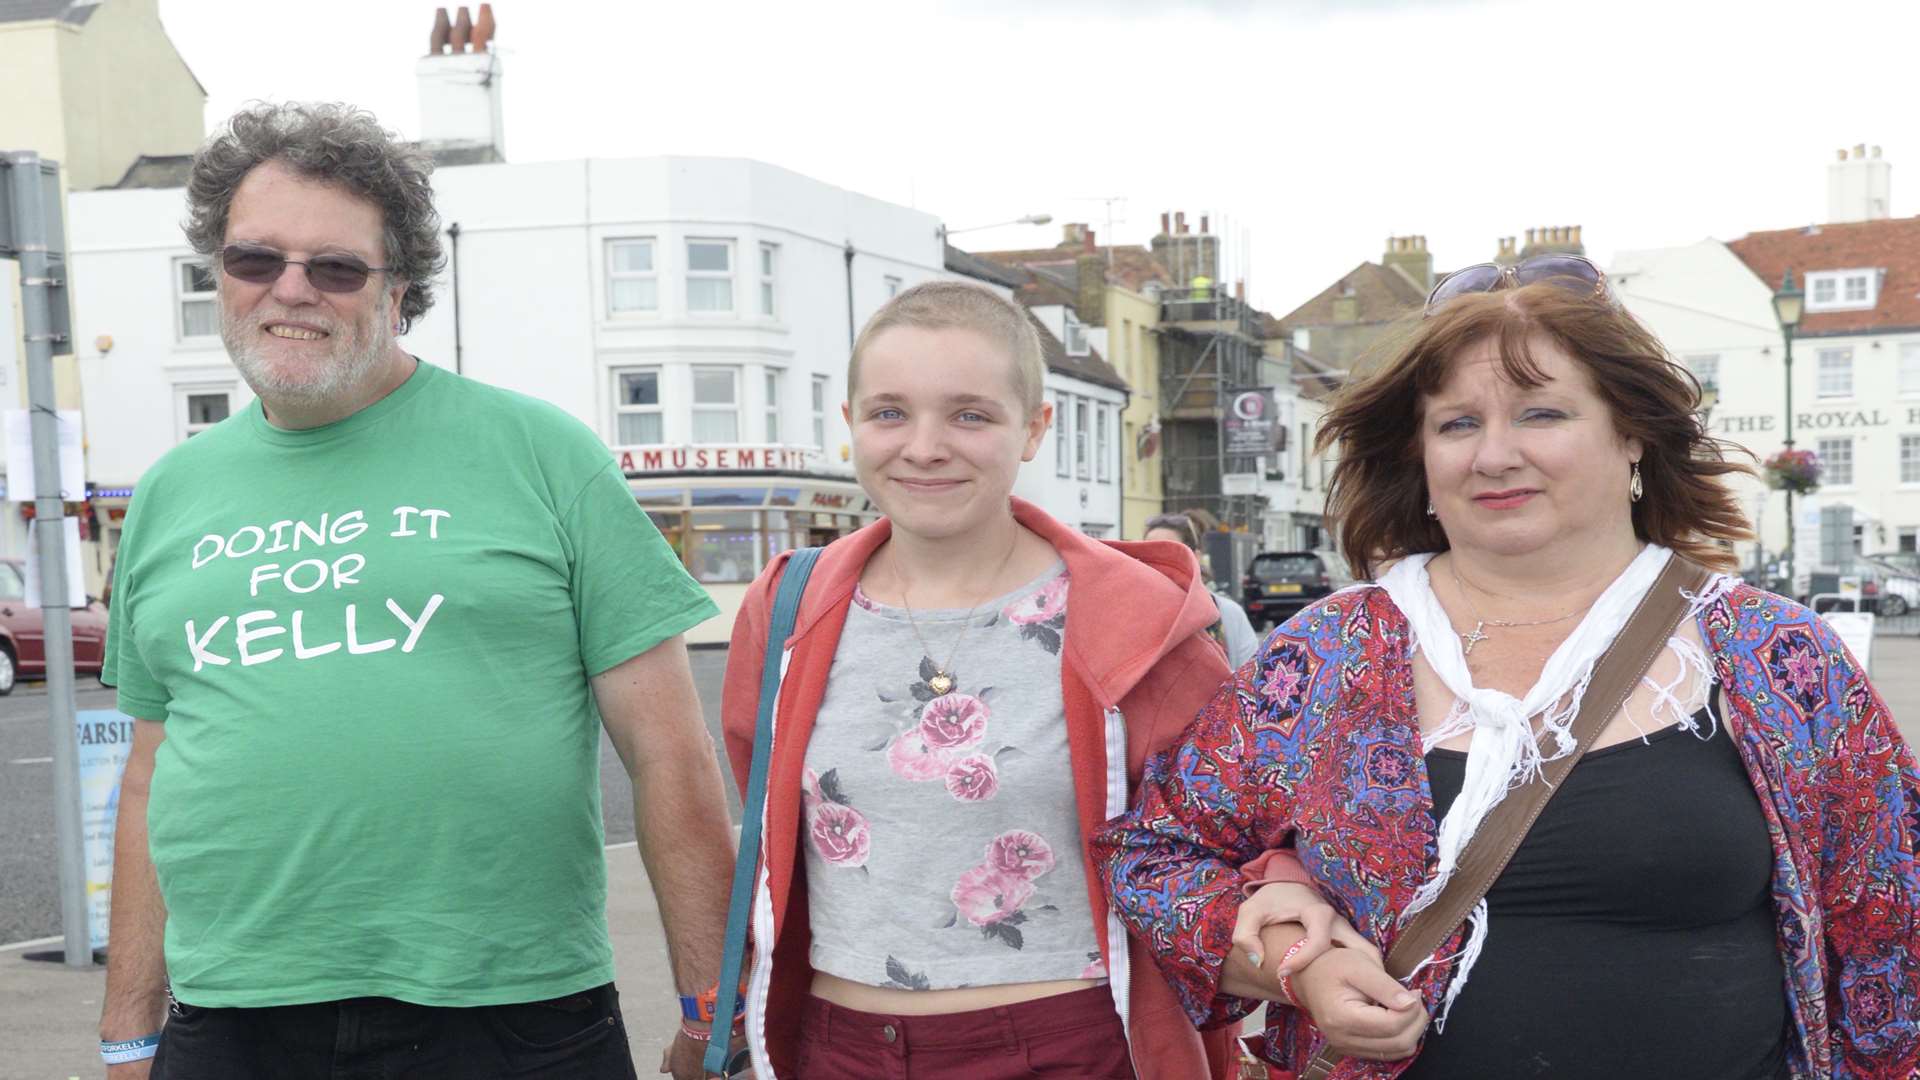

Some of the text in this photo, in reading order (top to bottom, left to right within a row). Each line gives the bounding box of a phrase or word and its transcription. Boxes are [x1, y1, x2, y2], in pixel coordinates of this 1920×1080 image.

[1720, 415, 1776, 433] THE
[1796, 410, 1889, 430] ROYAL
[620, 447, 805, 470] AMUSEMENTS
[192, 506, 451, 569] DOING IT
[250, 553, 366, 596] FOR
[185, 594, 444, 672] KELLY
